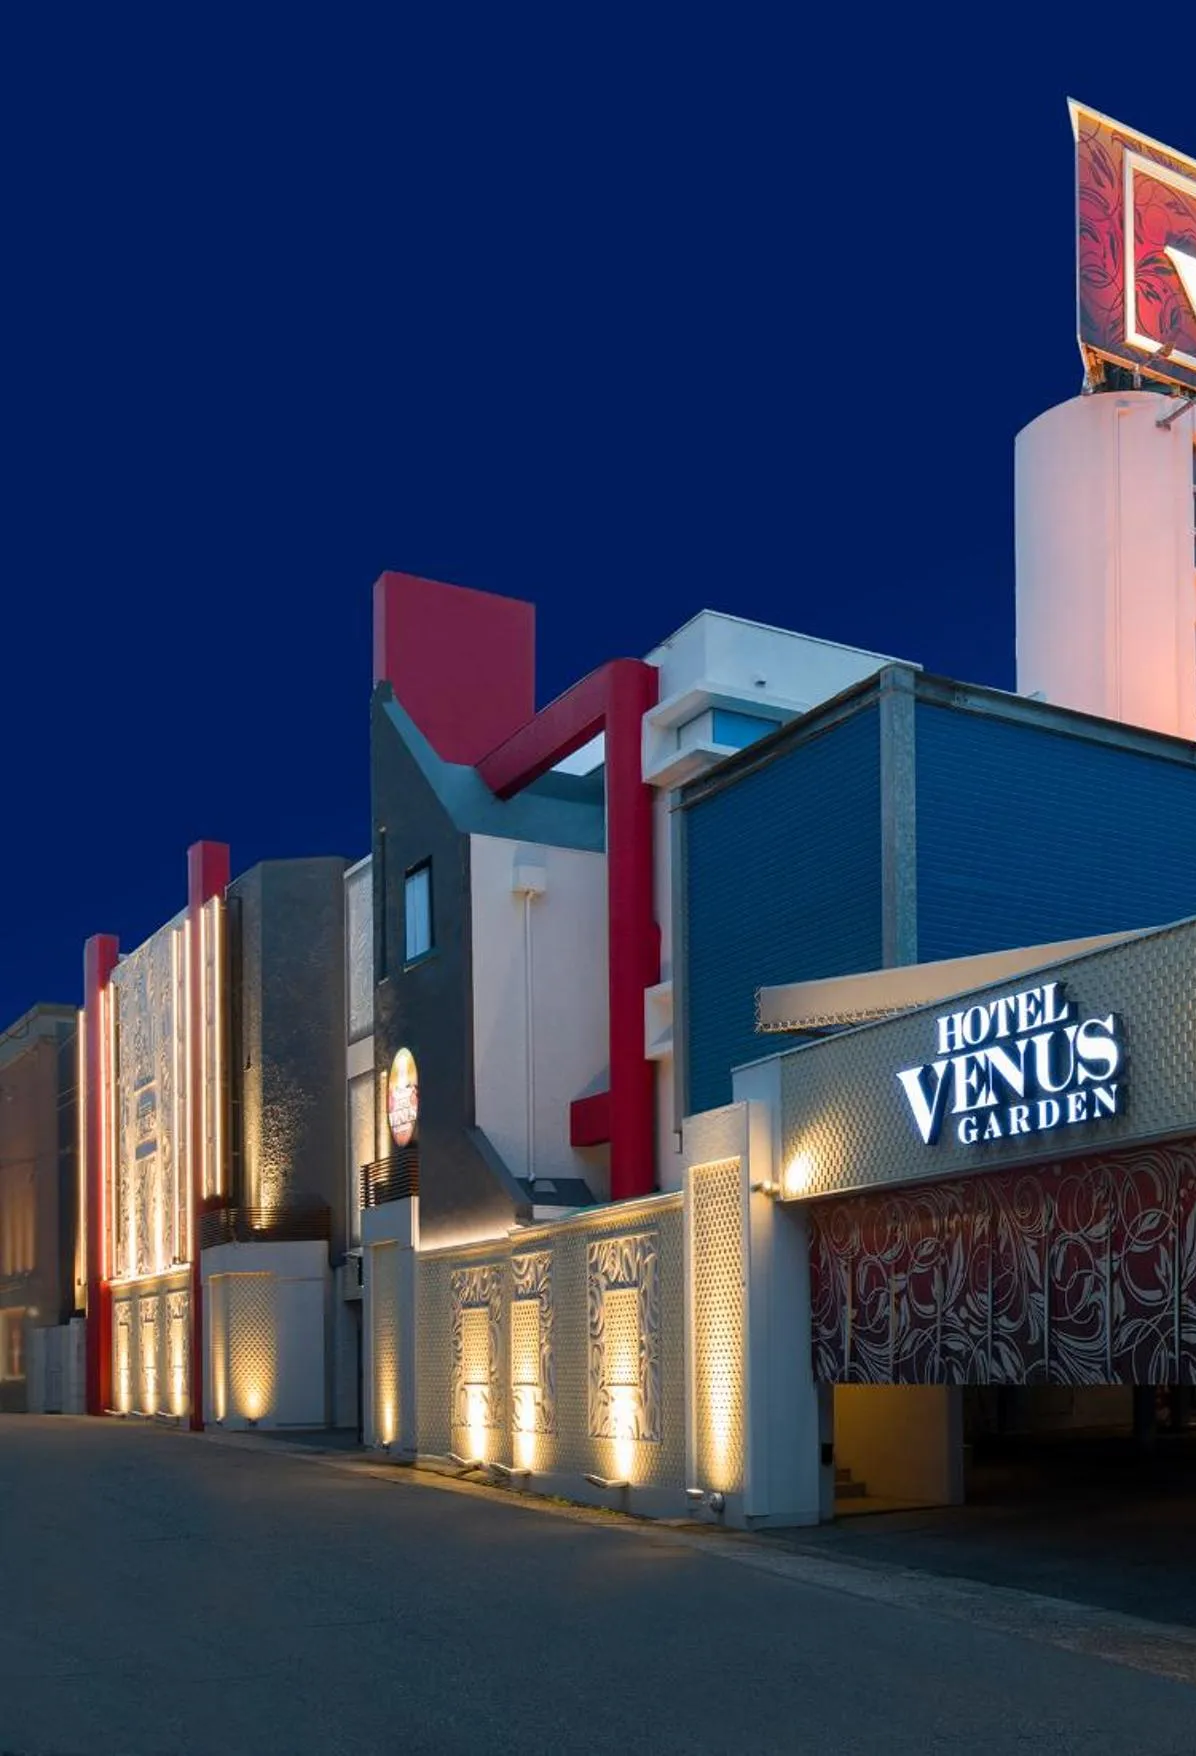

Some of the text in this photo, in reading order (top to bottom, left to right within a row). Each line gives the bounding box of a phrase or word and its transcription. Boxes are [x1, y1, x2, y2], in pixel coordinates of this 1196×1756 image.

[937, 983, 1068, 1054] HOTEL
[896, 1014, 1119, 1145] VENUS
[958, 1084, 1117, 1144] GARDEN
